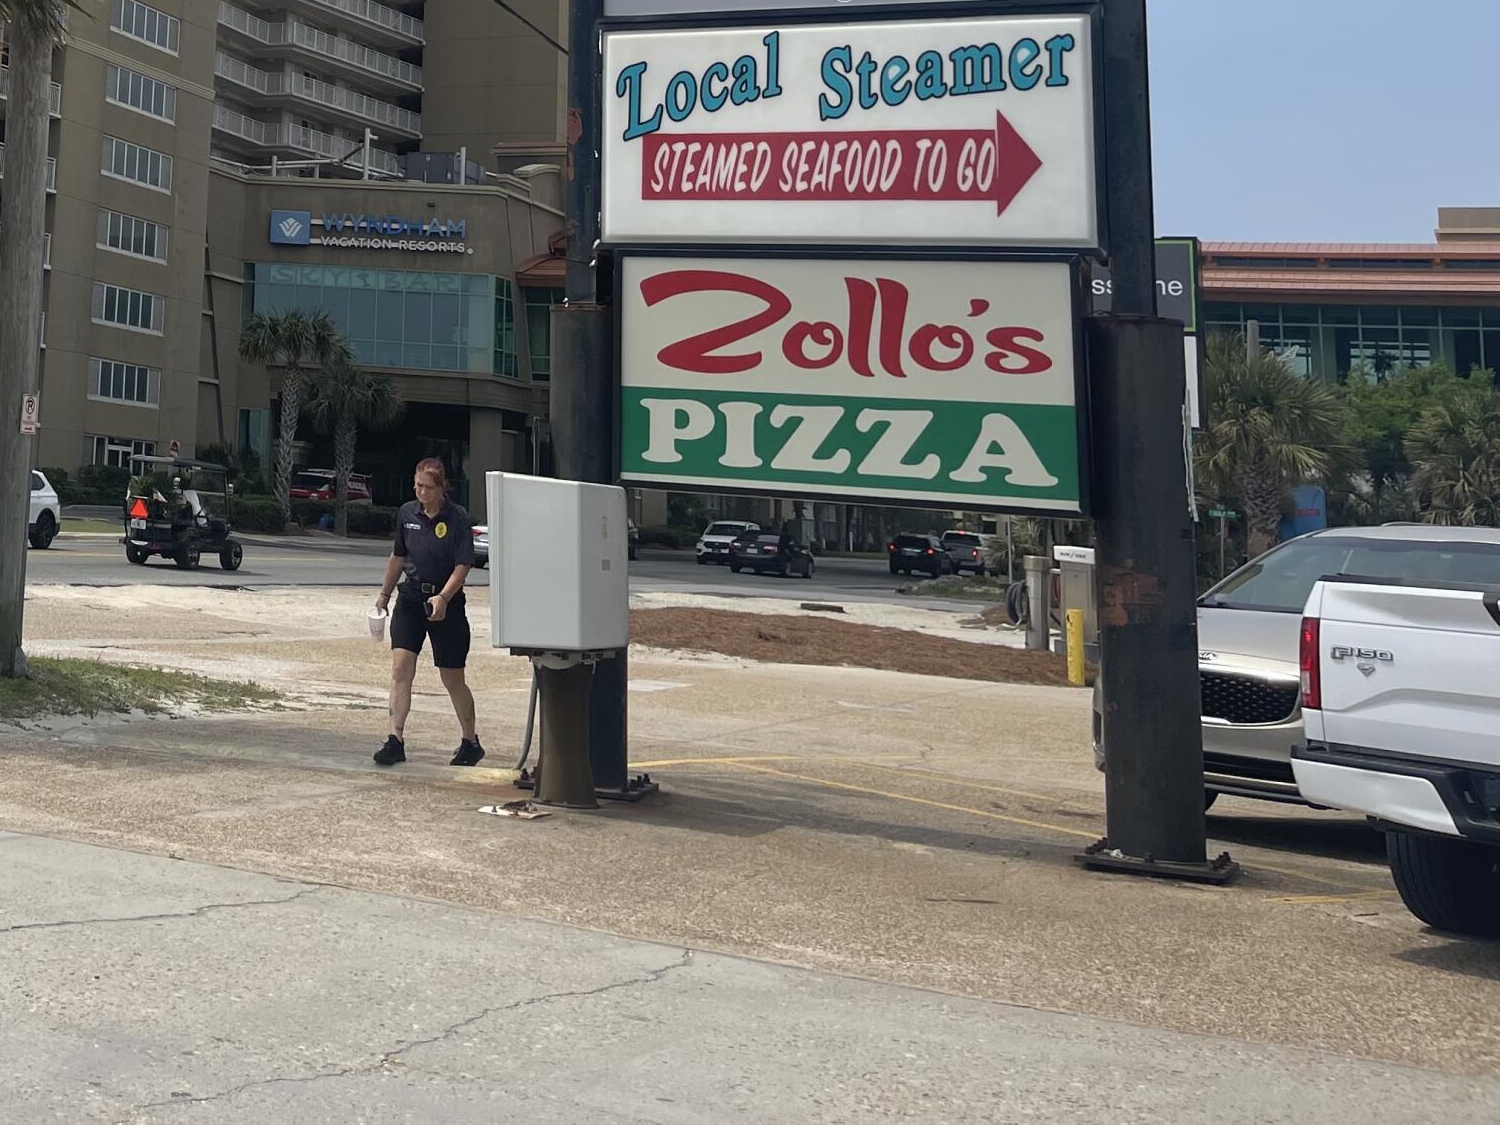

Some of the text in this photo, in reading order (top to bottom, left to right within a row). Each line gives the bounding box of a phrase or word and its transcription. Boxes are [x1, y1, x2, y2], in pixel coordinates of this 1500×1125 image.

[616, 31, 1075, 142] Local Steamer
[651, 138, 997, 194] STEAMED SEAFOOD TO GO
[320, 235, 392, 250] VACATION
[322, 212, 467, 238] WYNDHAM
[640, 269, 1053, 378] Zollo's
[640, 397, 1059, 487] PIZZA
